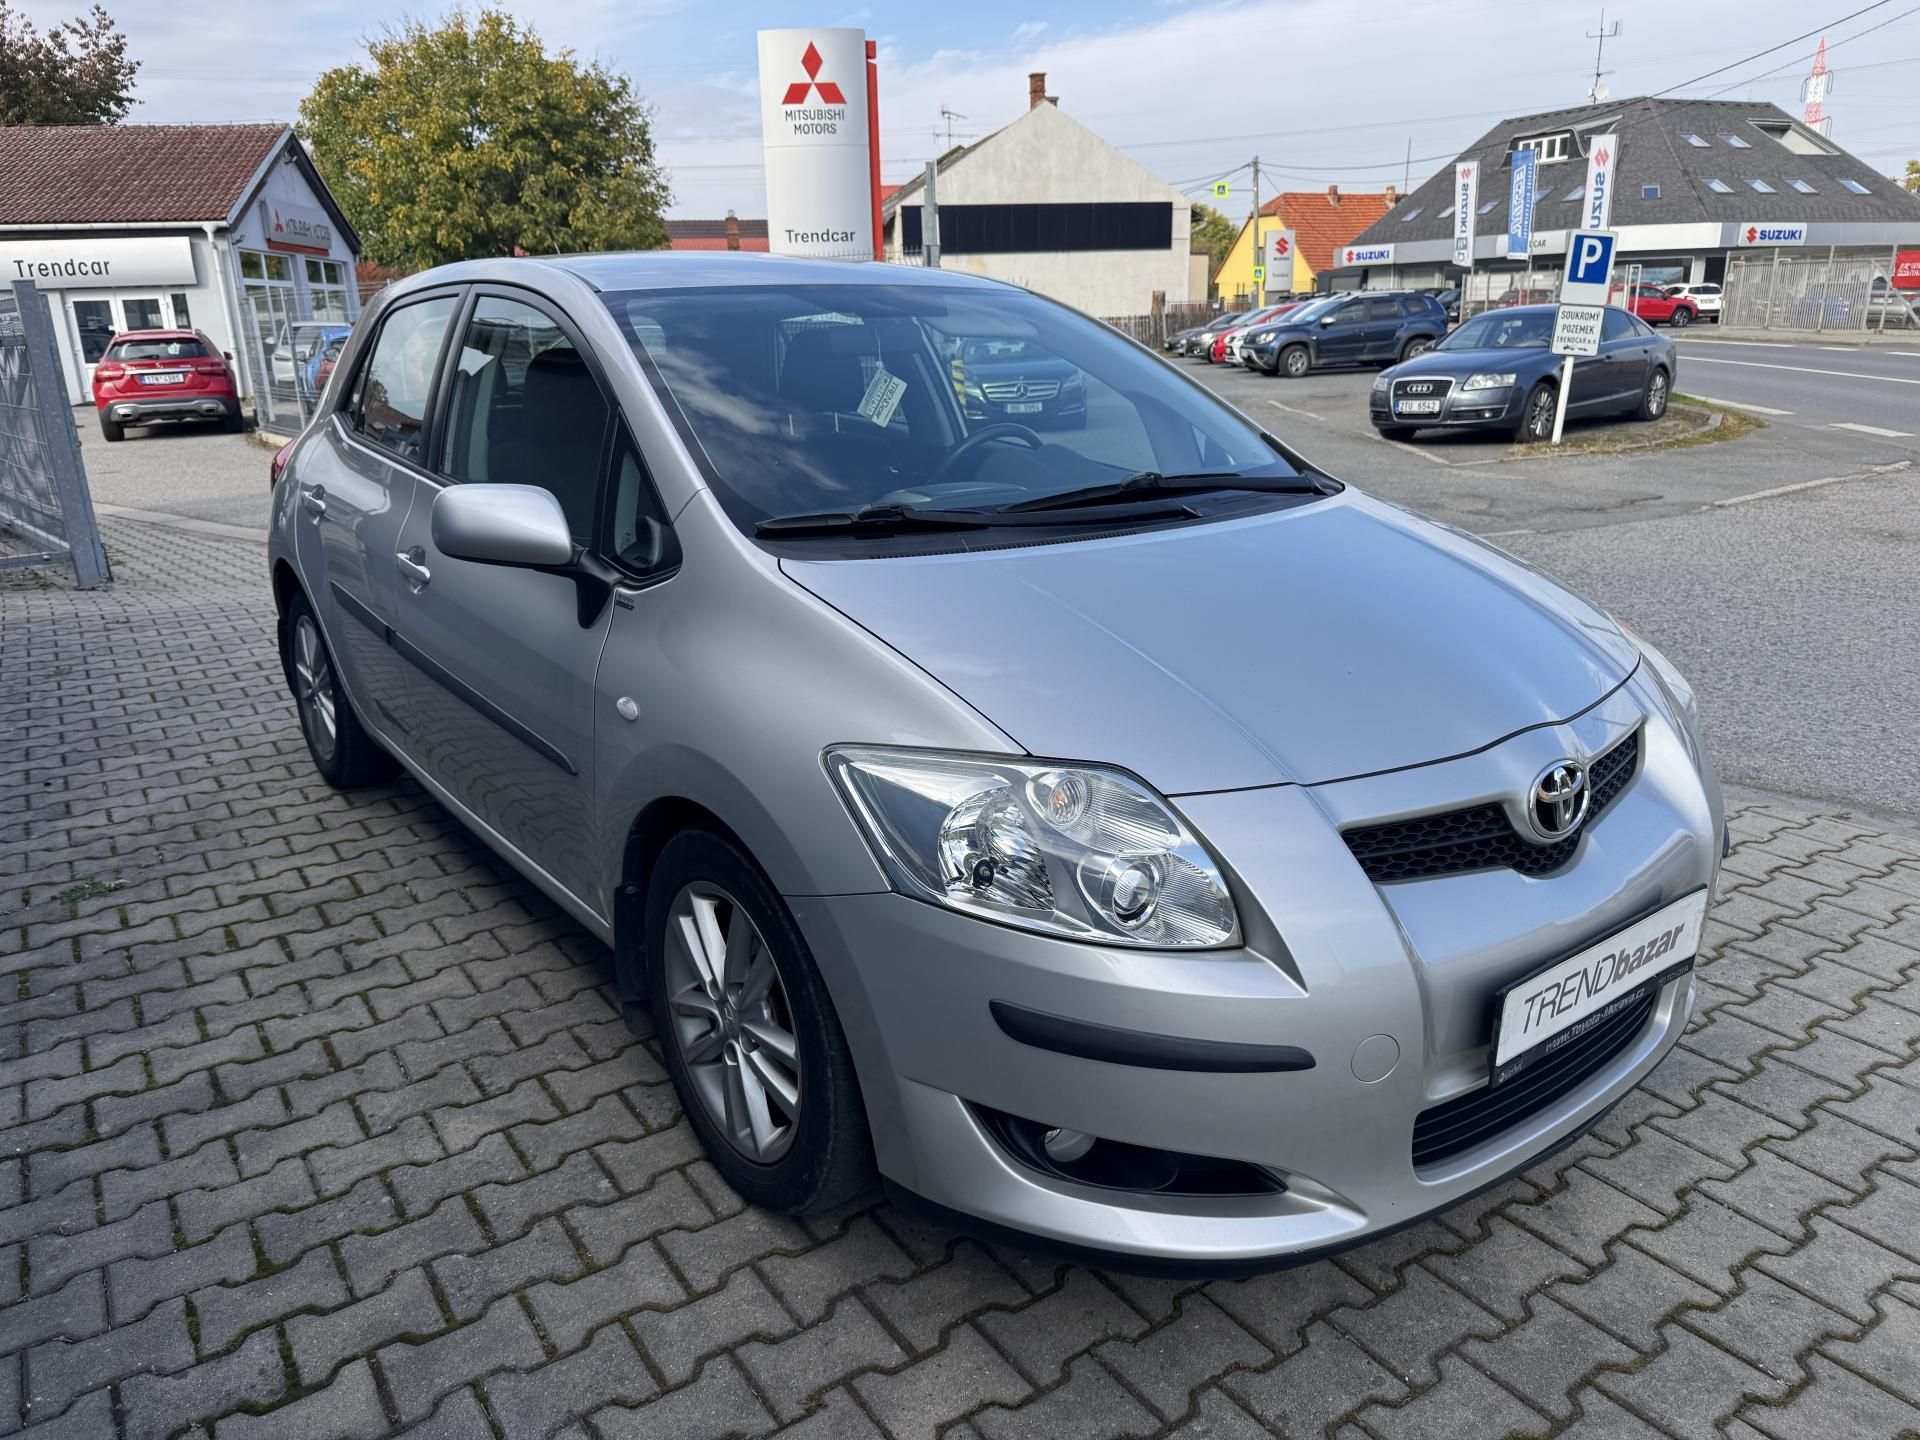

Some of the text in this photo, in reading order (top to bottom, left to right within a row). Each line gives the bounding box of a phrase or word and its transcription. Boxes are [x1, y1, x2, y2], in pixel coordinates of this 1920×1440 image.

[785, 109, 845, 121] MITSUBISHI
[794, 123, 837, 135] MOTORS
[785, 228, 856, 243] Trendcar
[1759, 229, 1802, 241] SUZUKI
[1355, 250, 1390, 261] SUZUKI
[1577, 237, 1603, 279] P
[13, 258, 110, 278] Trendcar
[1560, 309, 1601, 321] SOUKROMÝ
[1561, 323, 1595, 335] POZEMEK
[1523, 922, 1685, 1034] TRENDbazar
